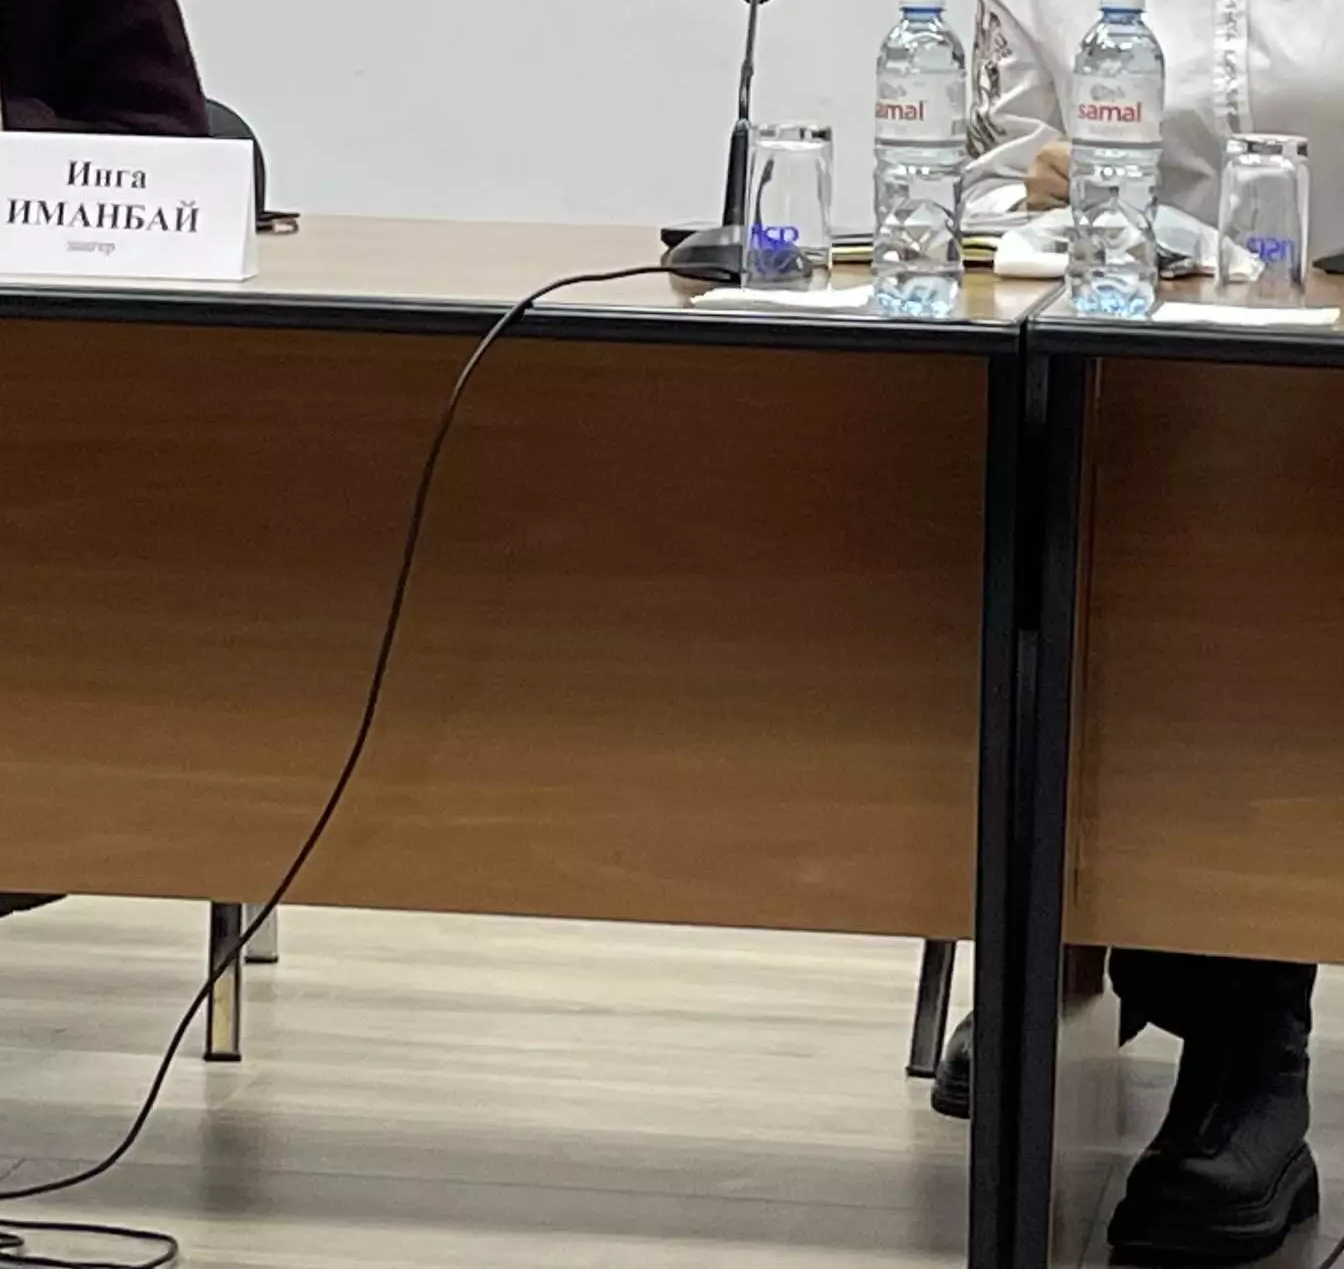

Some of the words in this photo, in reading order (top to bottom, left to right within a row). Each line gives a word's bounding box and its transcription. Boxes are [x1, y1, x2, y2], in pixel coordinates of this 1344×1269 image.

[875, 99, 925, 122] amal
[1077, 101, 1142, 123] samal
[66, 159, 147, 189] Инга
[5, 197, 200, 233] ИМАНБАЙ
